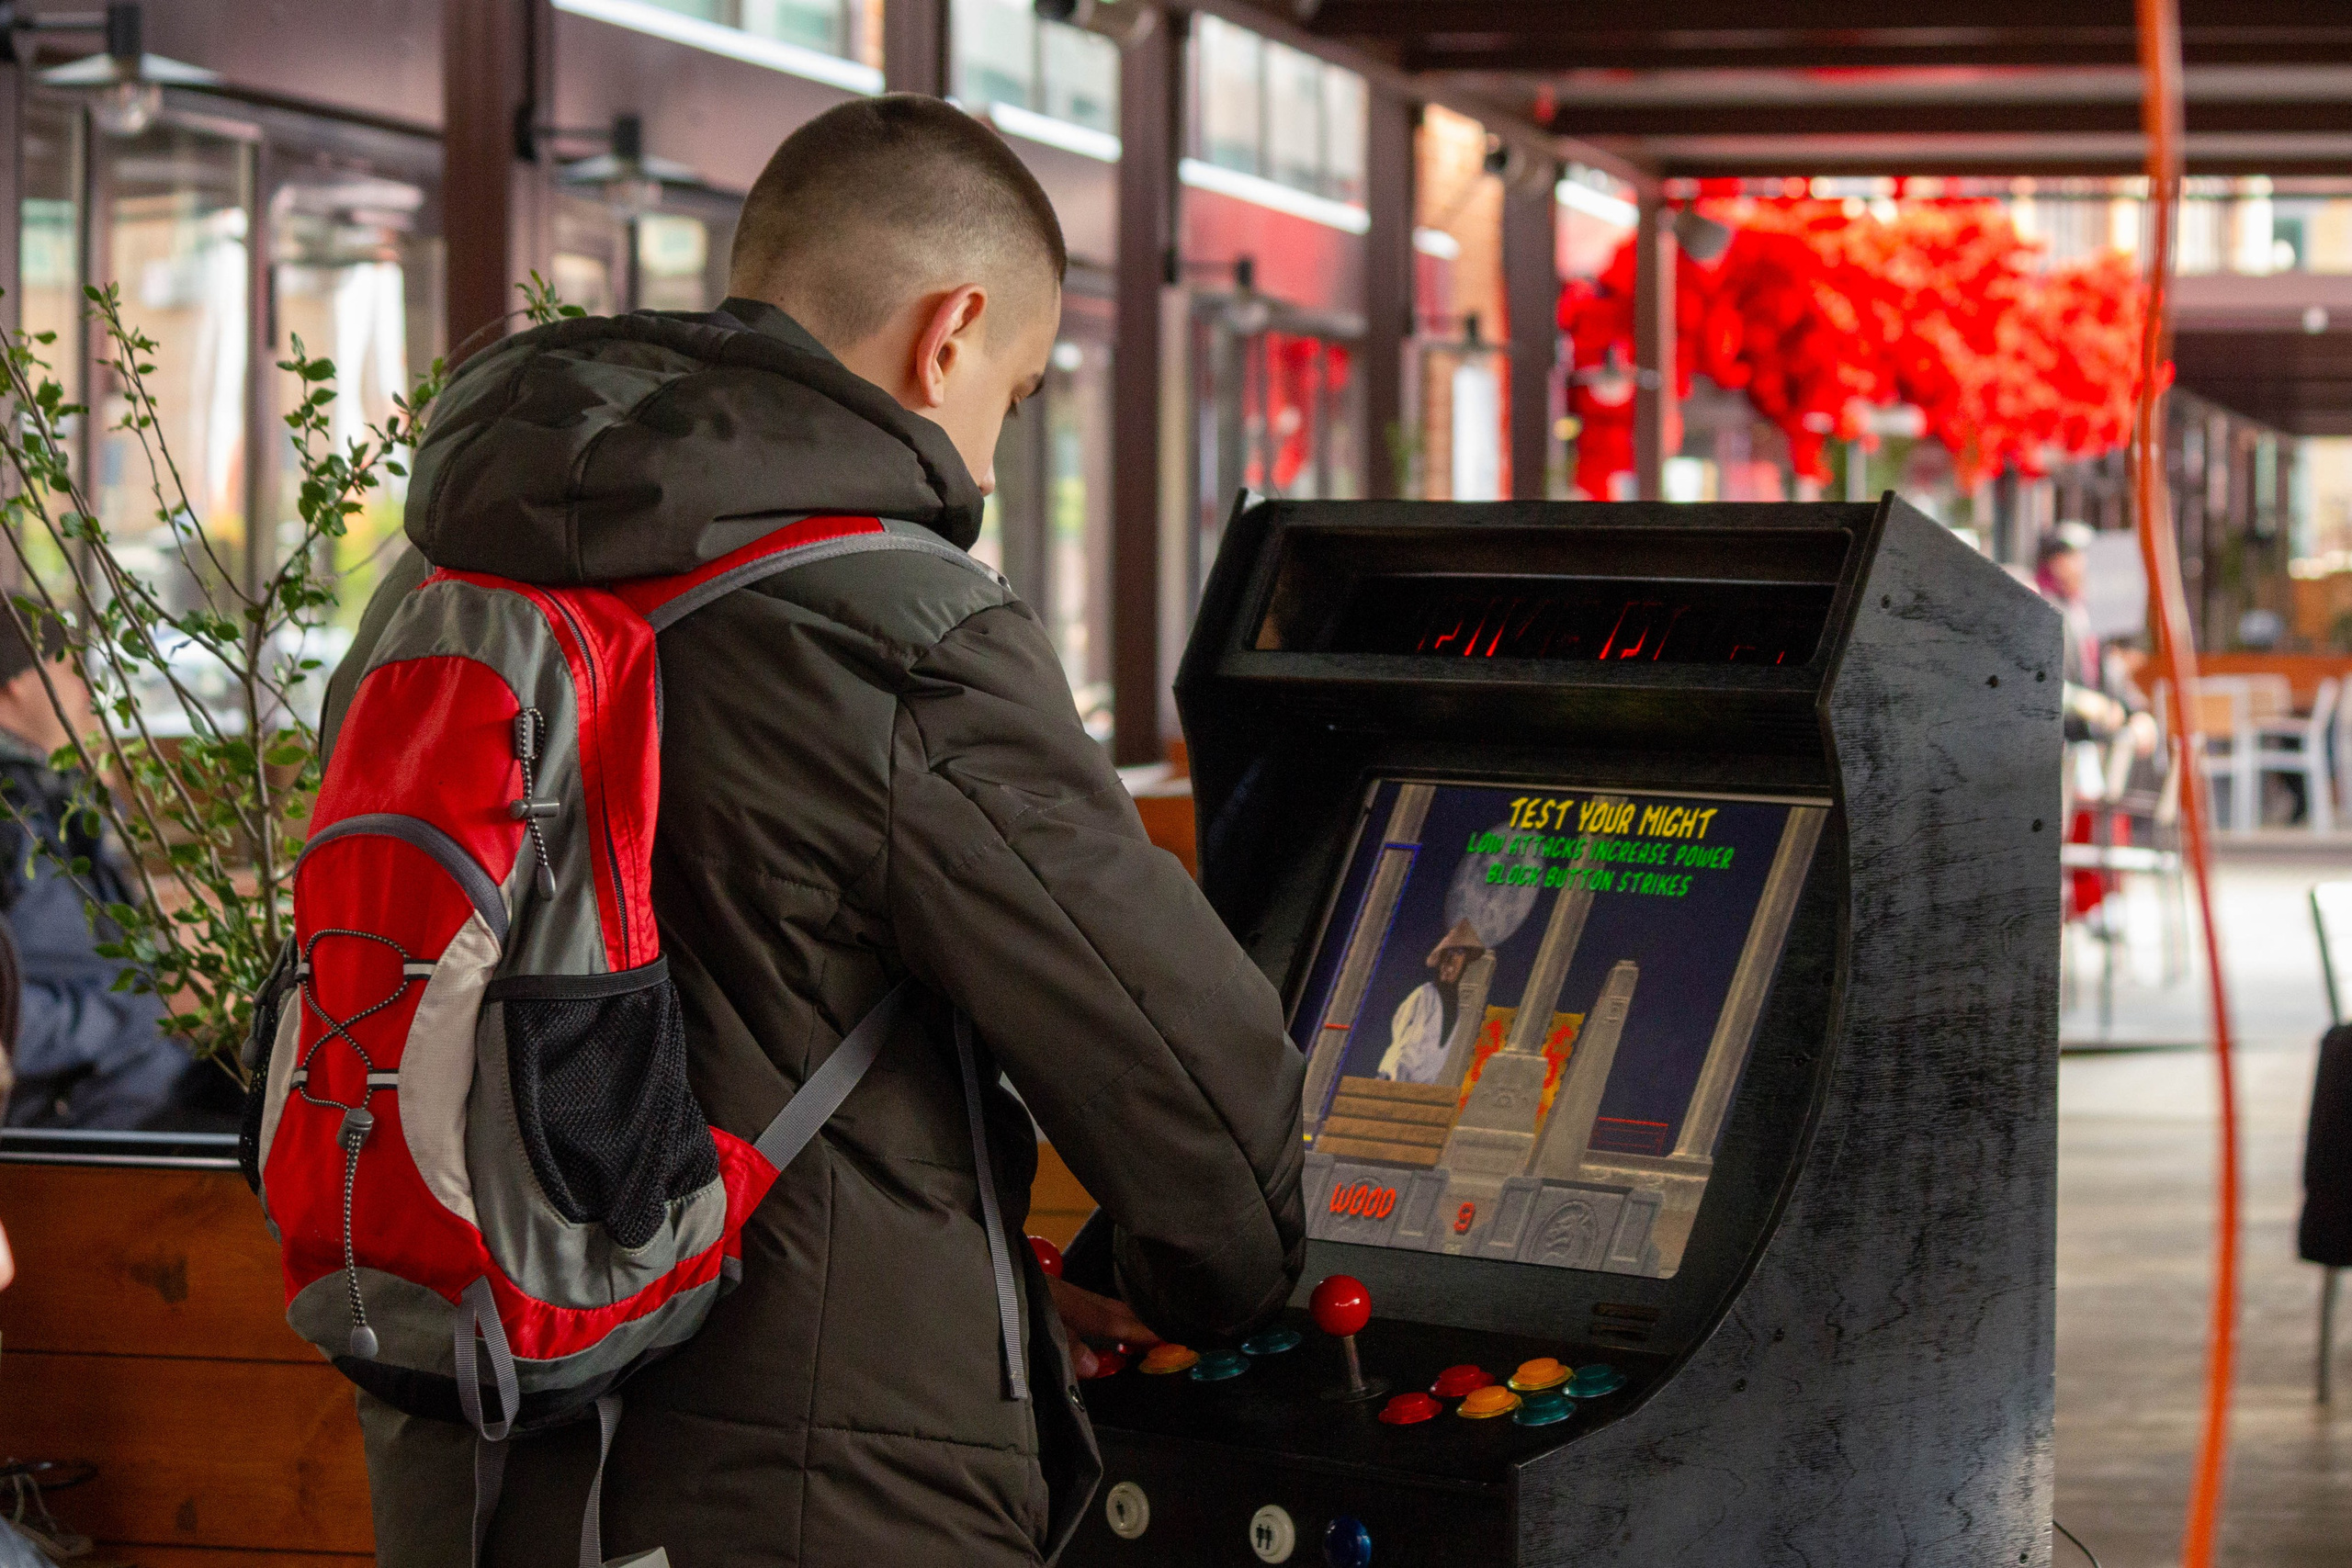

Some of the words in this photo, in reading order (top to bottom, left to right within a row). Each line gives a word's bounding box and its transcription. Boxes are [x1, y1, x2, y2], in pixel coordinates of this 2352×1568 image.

[1510, 797, 1574, 830] TEST
[1577, 801, 1635, 834] YOUR
[1637, 805, 1718, 839] MIGHT
[1466, 831, 1506, 854] LOW
[1508, 835, 1587, 860] ATTACKS
[1589, 840, 1672, 865] INCREASE
[1673, 845, 1735, 869] POWER
[1486, 862, 1542, 886] BLOCK
[1544, 866, 1615, 891] BUTTON
[1617, 871, 1692, 897] STRIKES
[1329, 1181, 1396, 1218] WOOD
[1453, 1201, 1475, 1232] 9
